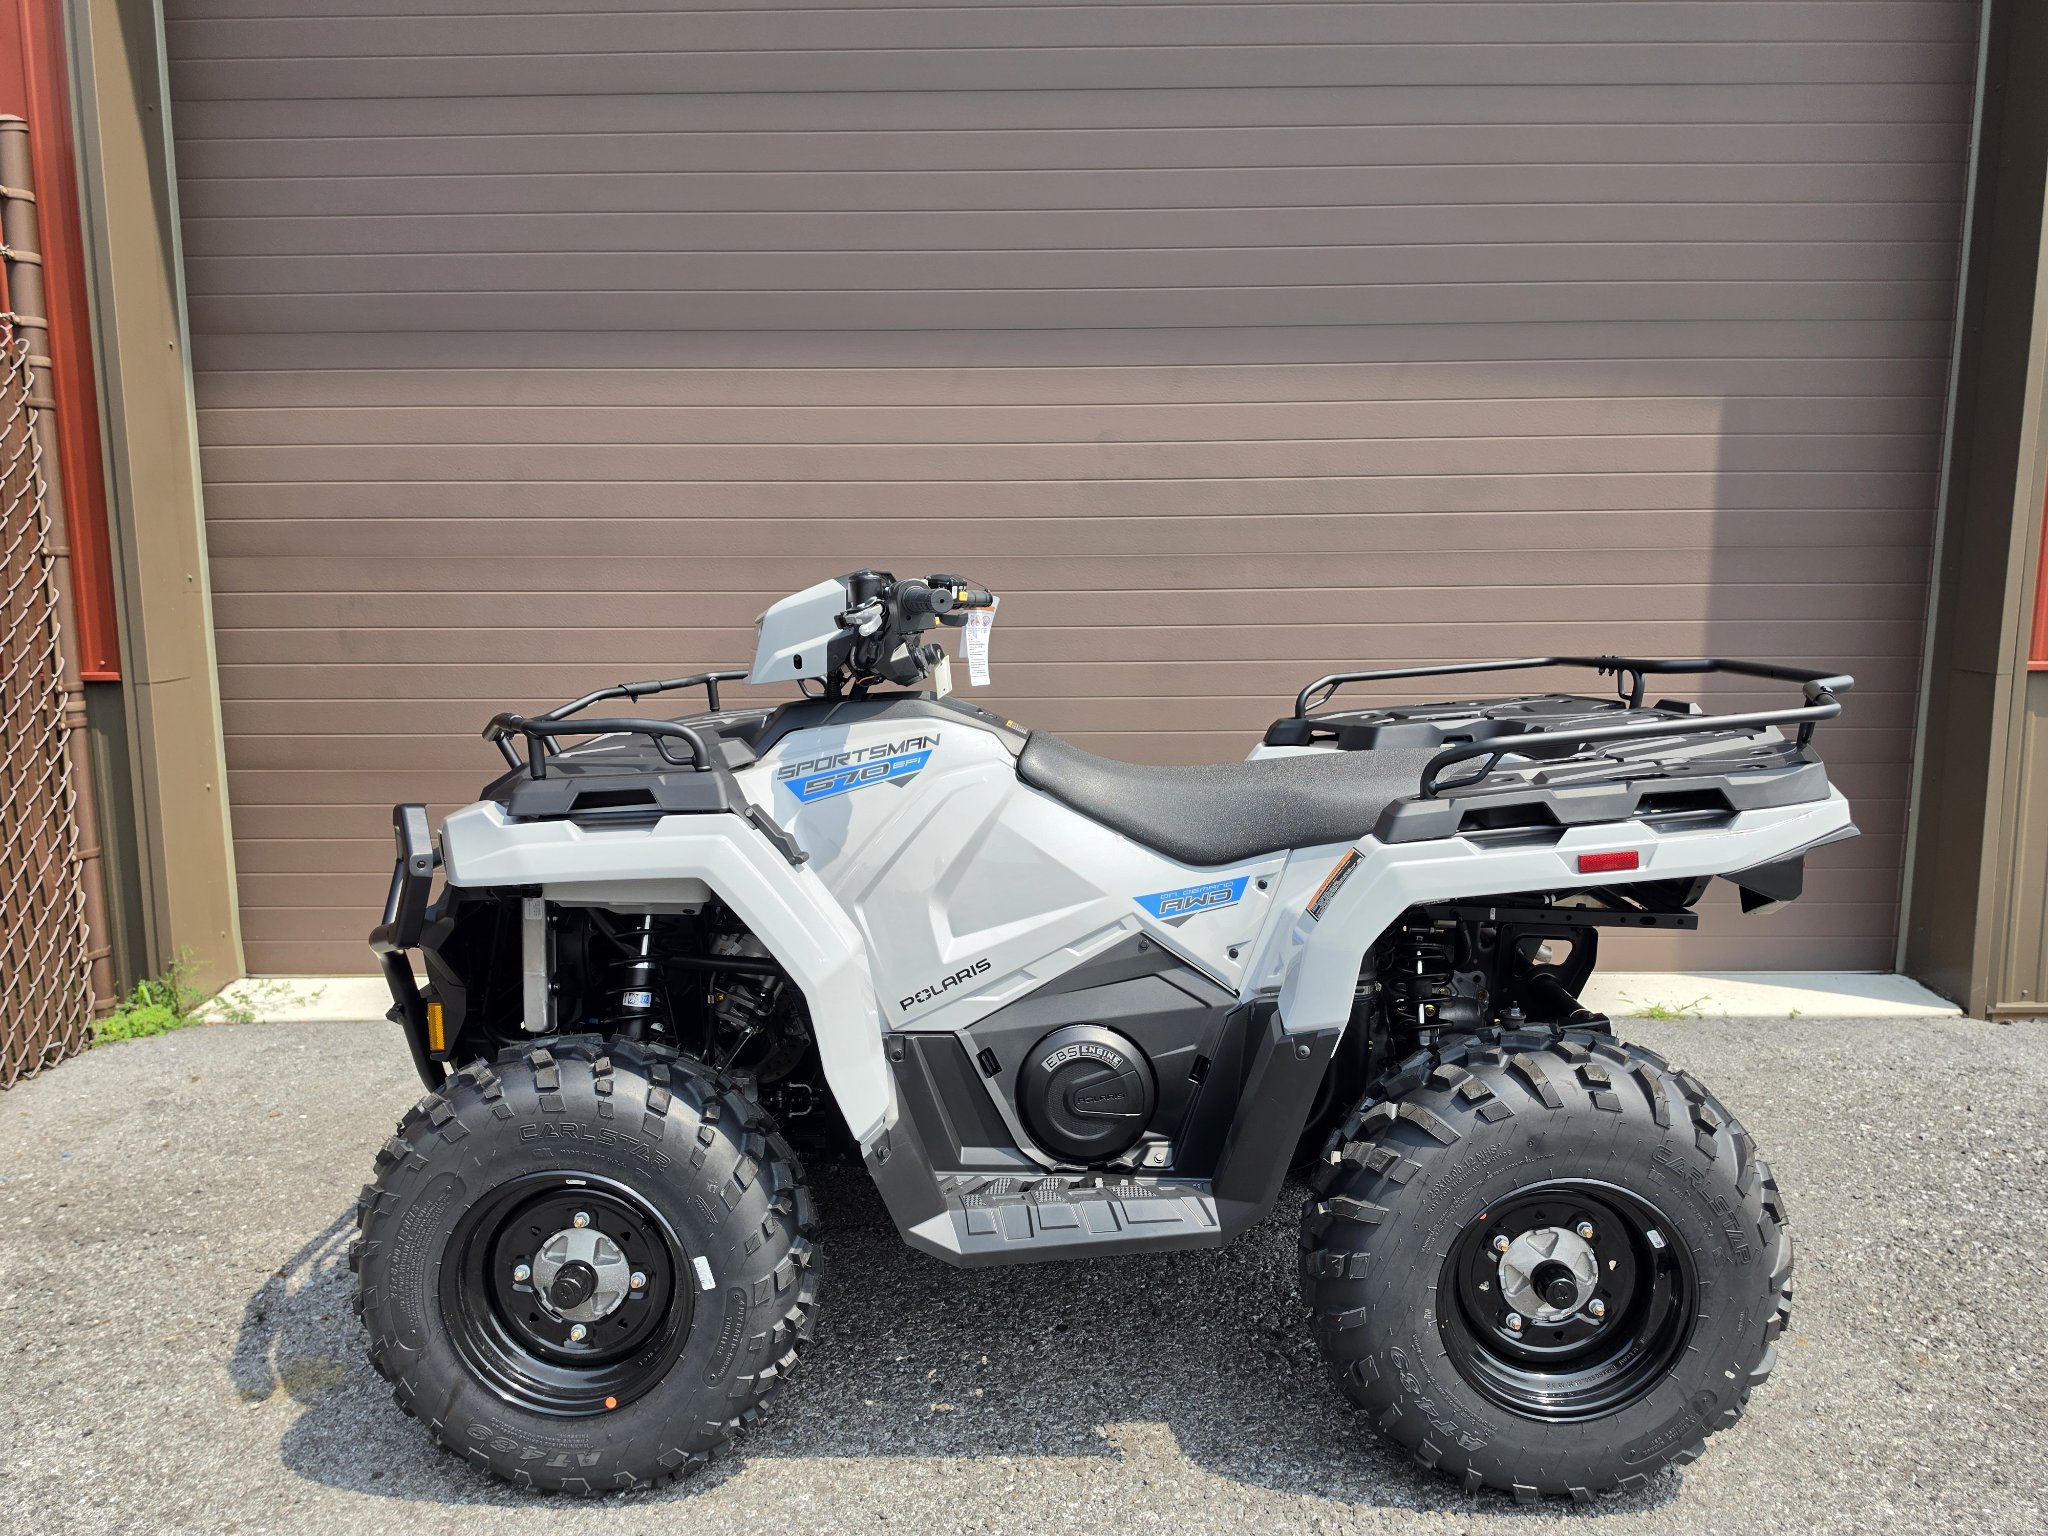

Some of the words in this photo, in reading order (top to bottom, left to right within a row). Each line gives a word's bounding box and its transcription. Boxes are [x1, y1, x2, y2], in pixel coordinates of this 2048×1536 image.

[777, 734, 941, 780] SPORTSMAN
[803, 762, 891, 795] 570
[892, 757, 921, 769] EFI
[1159, 888, 1233, 914] AWD
[1182, 882, 1233, 896] DEMAND
[899, 958, 991, 1011] POLARIS
[1045, 1046, 1078, 1069] EBS
[1081, 1045, 1121, 1064] ENGINE
[1077, 1093, 1126, 1104] POLARIS
[519, 1122, 672, 1172] CARLSTAR
[1652, 1144, 1751, 1264] CARLSTAR
[1391, 1346, 1488, 1451] AT489
[466, 1424, 604, 1467] AT489
